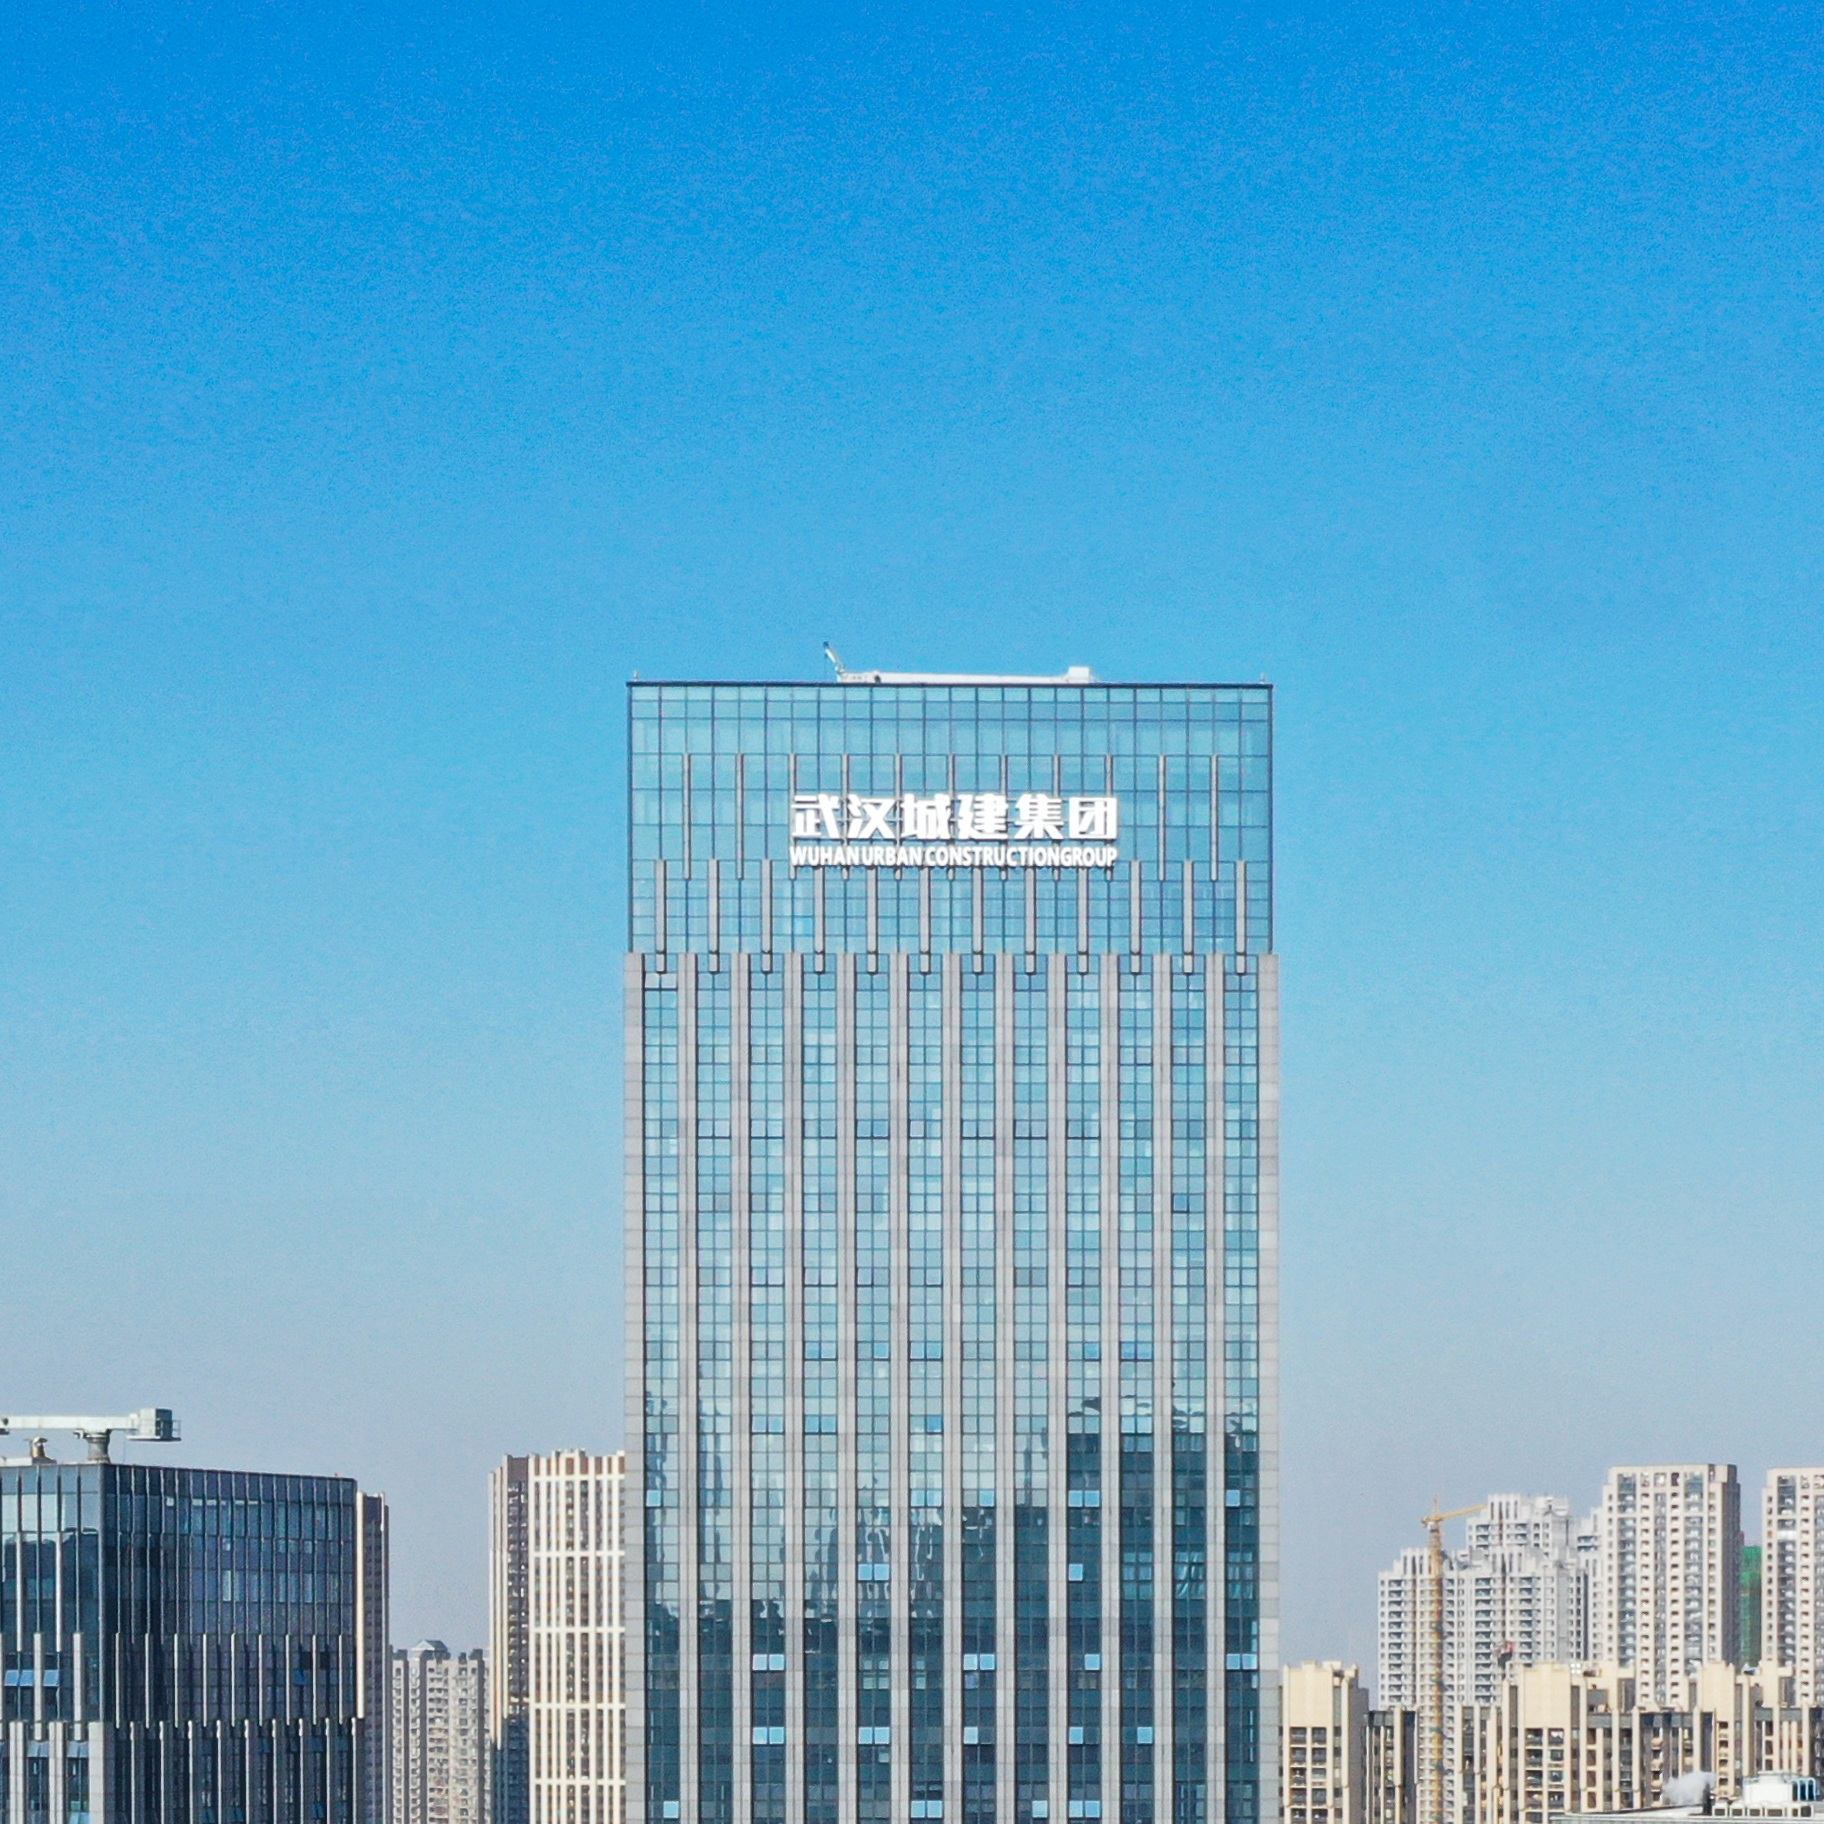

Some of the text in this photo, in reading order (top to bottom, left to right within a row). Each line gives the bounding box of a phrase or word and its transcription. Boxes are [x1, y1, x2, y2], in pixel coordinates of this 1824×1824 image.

[791, 793, 1118, 840] 武汉城建集团
[790, 846, 859, 867] WUHAN
[862, 846, 922, 867] URBAN
